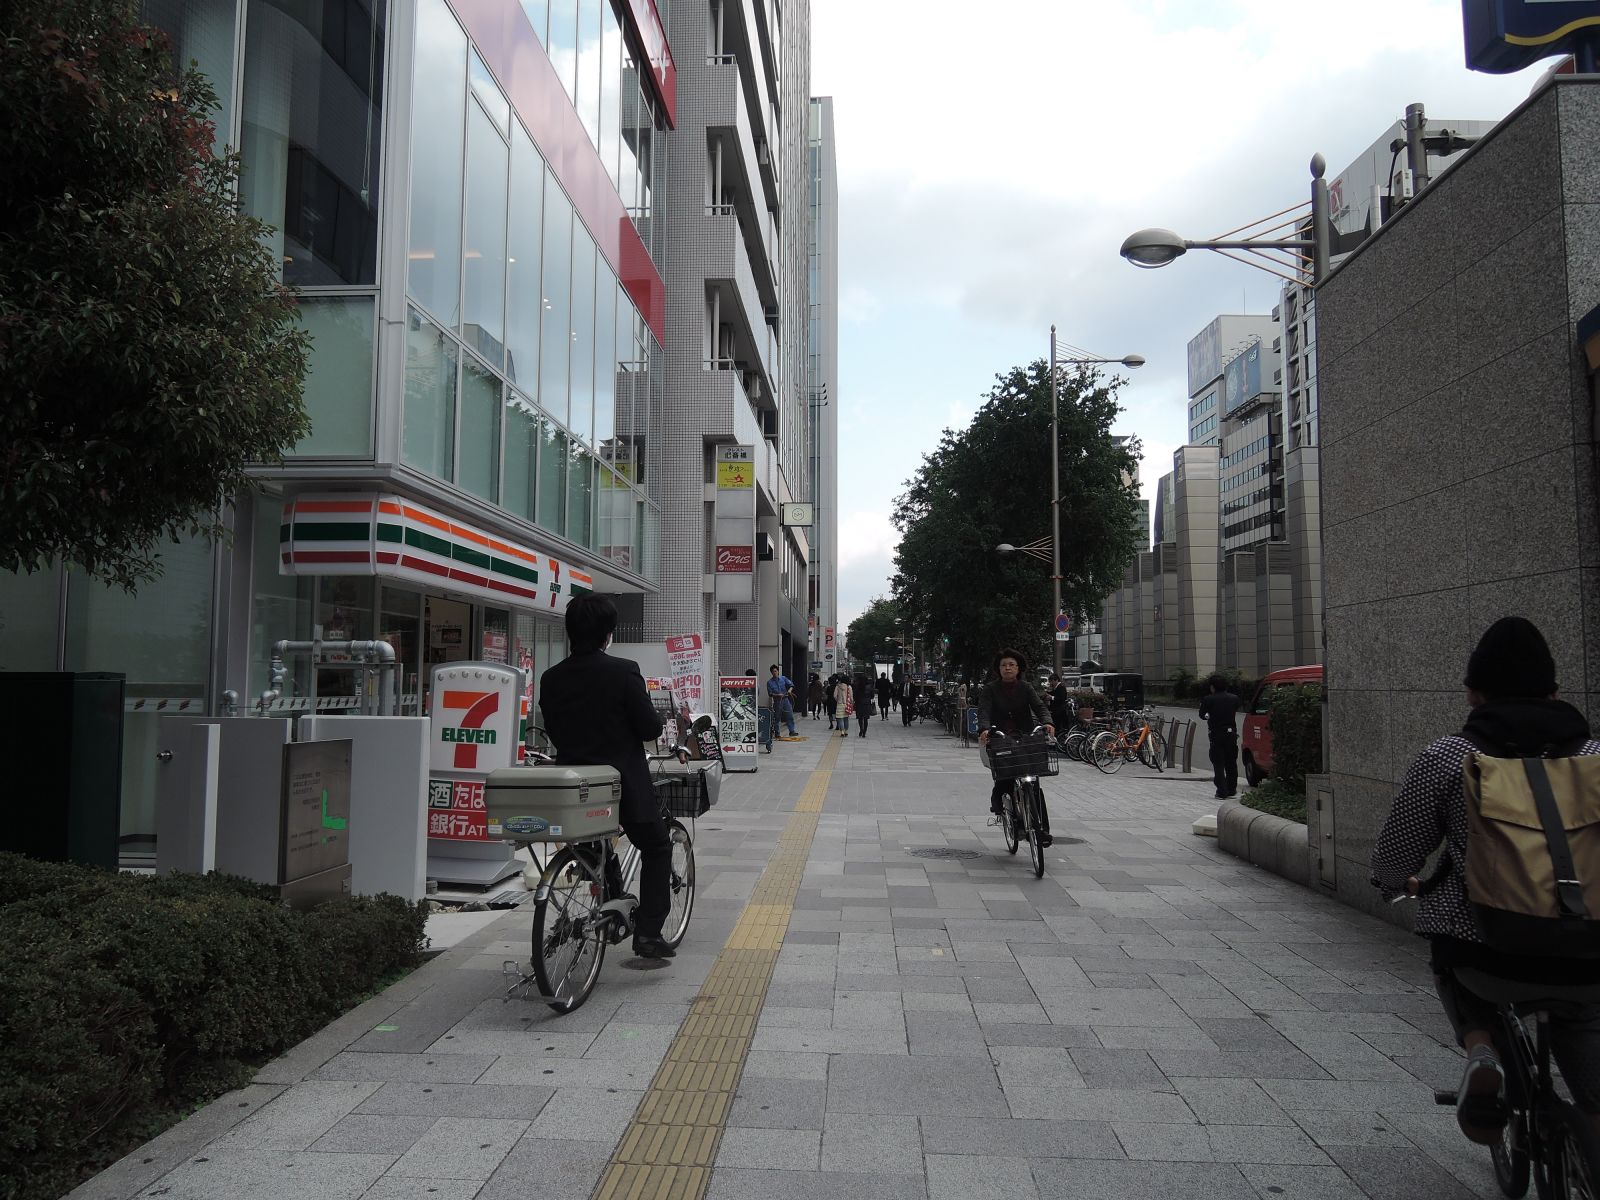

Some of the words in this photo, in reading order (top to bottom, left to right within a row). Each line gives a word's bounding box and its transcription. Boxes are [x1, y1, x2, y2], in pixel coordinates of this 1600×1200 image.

[443, 690, 500, 769] 7
[721, 721, 756, 732] 24時間
[721, 731, 742, 743] 営業
[737, 744, 755, 753] 入口
[429, 781, 452, 808] 酒
